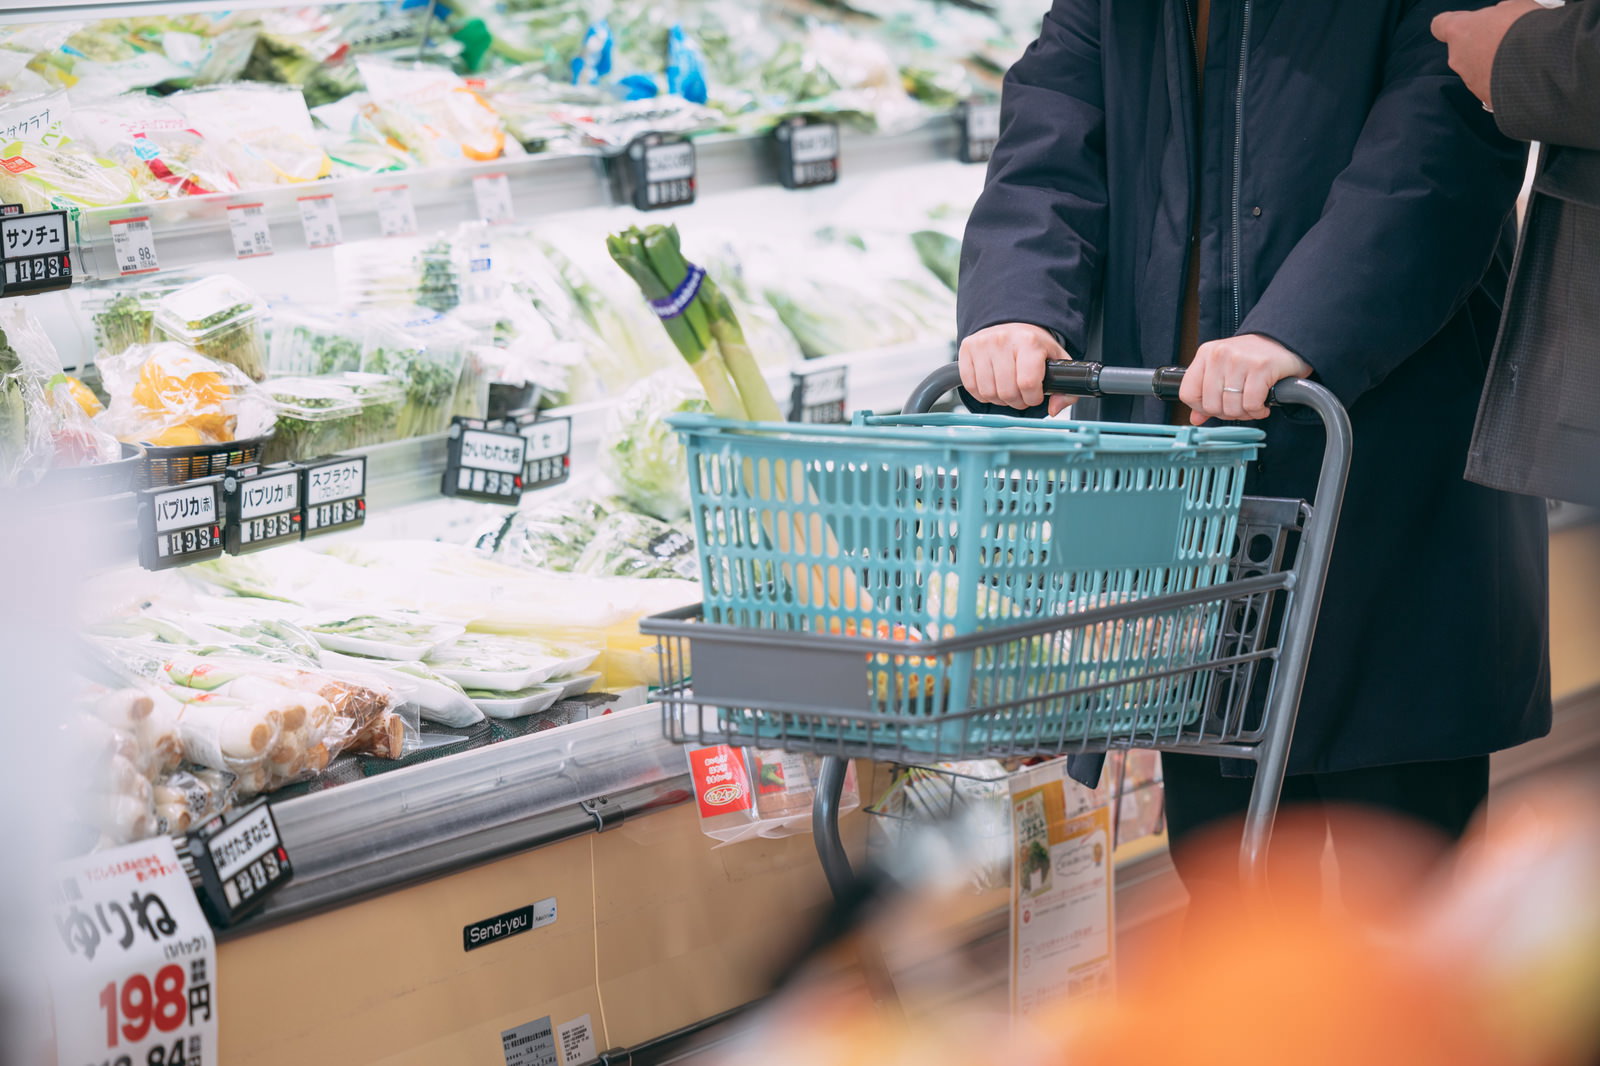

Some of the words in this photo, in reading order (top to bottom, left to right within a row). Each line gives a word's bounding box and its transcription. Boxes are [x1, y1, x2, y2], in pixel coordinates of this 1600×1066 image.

[6, 225, 60, 249] サンチュ
[138, 247, 151, 260] 98
[21, 259, 58, 280] 128
[312, 465, 358, 487] スプラウト
[158, 496, 213, 521] パプリカ(赤)
[323, 503, 354, 523] 118
[255, 516, 288, 538] 198
[173, 530, 208, 552] 198
[55, 889, 177, 962] ゆりね
[470, 914, 527, 942] Send-you
[99, 963, 187, 1048] 198
[188, 983, 210, 1026] 円
